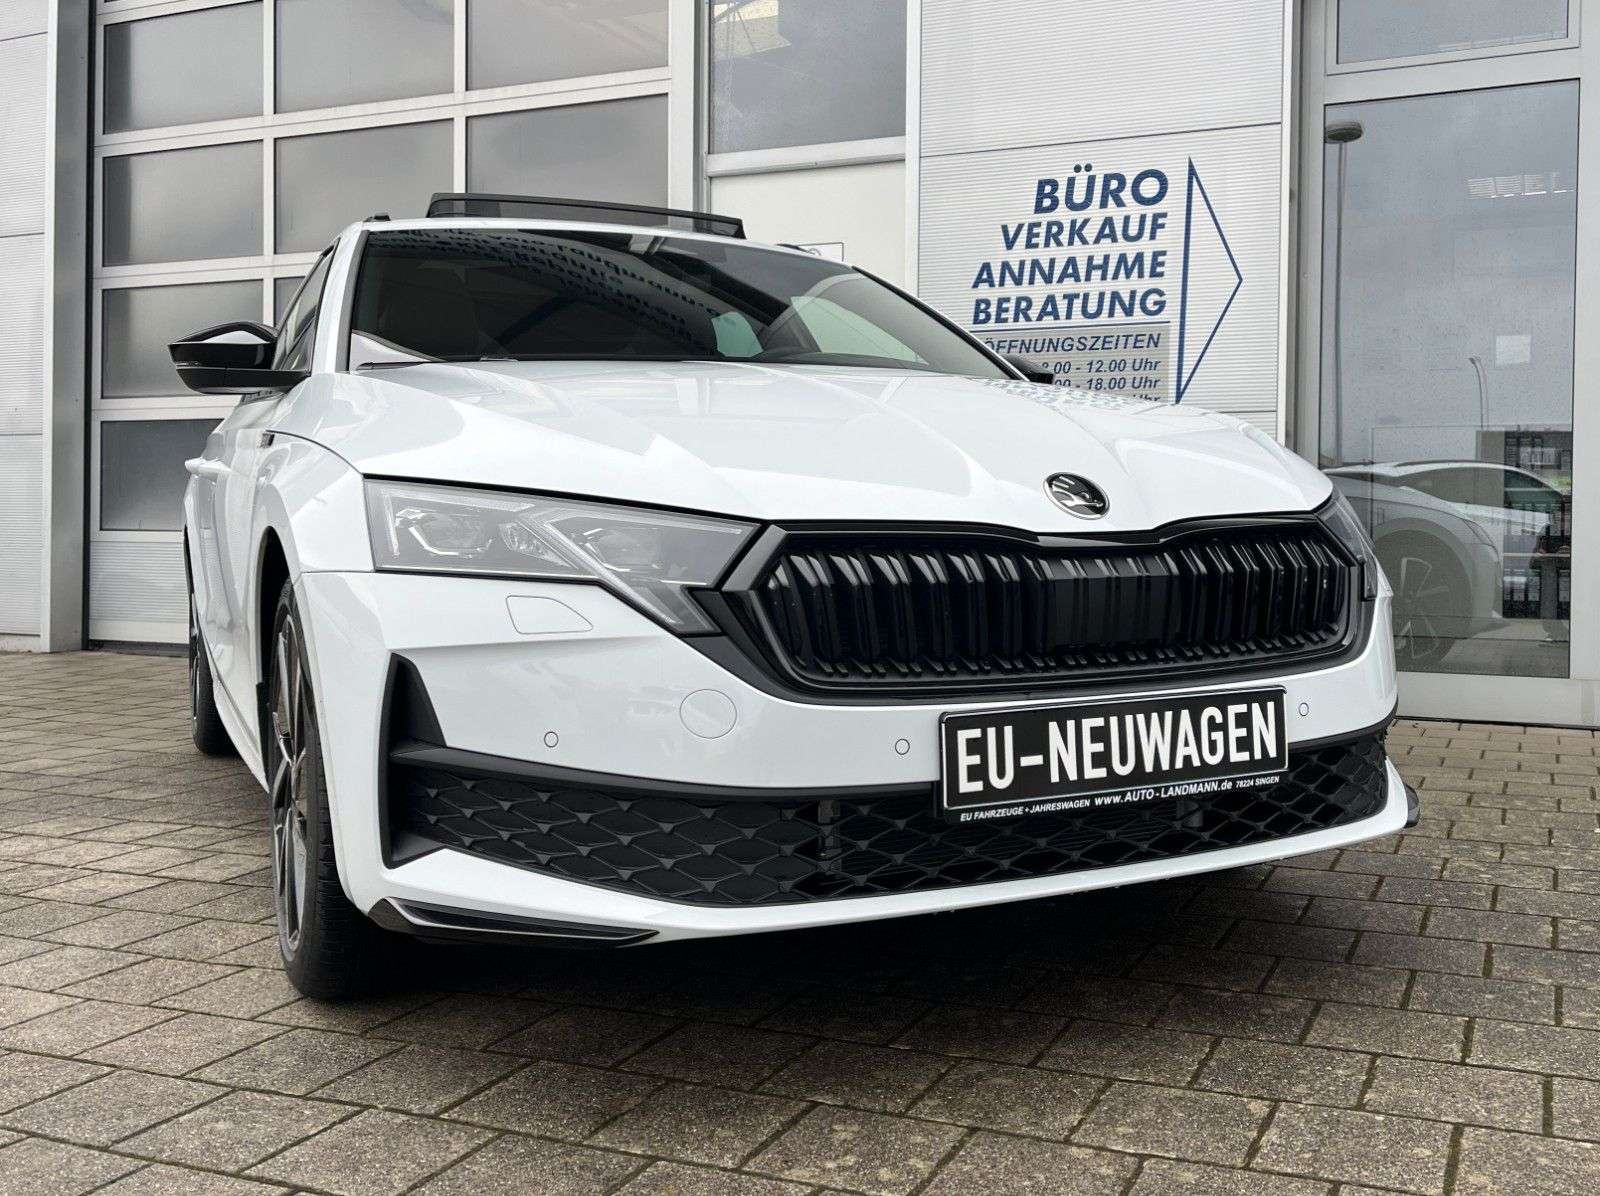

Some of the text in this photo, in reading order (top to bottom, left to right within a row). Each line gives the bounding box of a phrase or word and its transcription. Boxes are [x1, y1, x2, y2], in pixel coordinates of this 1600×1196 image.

[1034, 163, 1169, 214] BÜRO
[1001, 212, 1168, 250] VERKAUF
[971, 250, 1167, 289] ANNAHME
[973, 288, 1167, 325] BERATUNG
[1086, 359, 1127, 374] 12.00
[1132, 358, 1161, 371] Uhr
[1086, 377, 1126, 390] 18.00
[1132, 376, 1161, 389] Uhr
[957, 701, 1278, 794] EU-NEUWAGEN
[960, 812, 973, 822] EU
[973, 806, 1024, 820] FAHRZEUGE
[1030, 799, 1091, 814] JAHRESWAGEN
[1236, 778, 1254, 788] 78224
[1255, 775, 1280, 787] SINGEN
